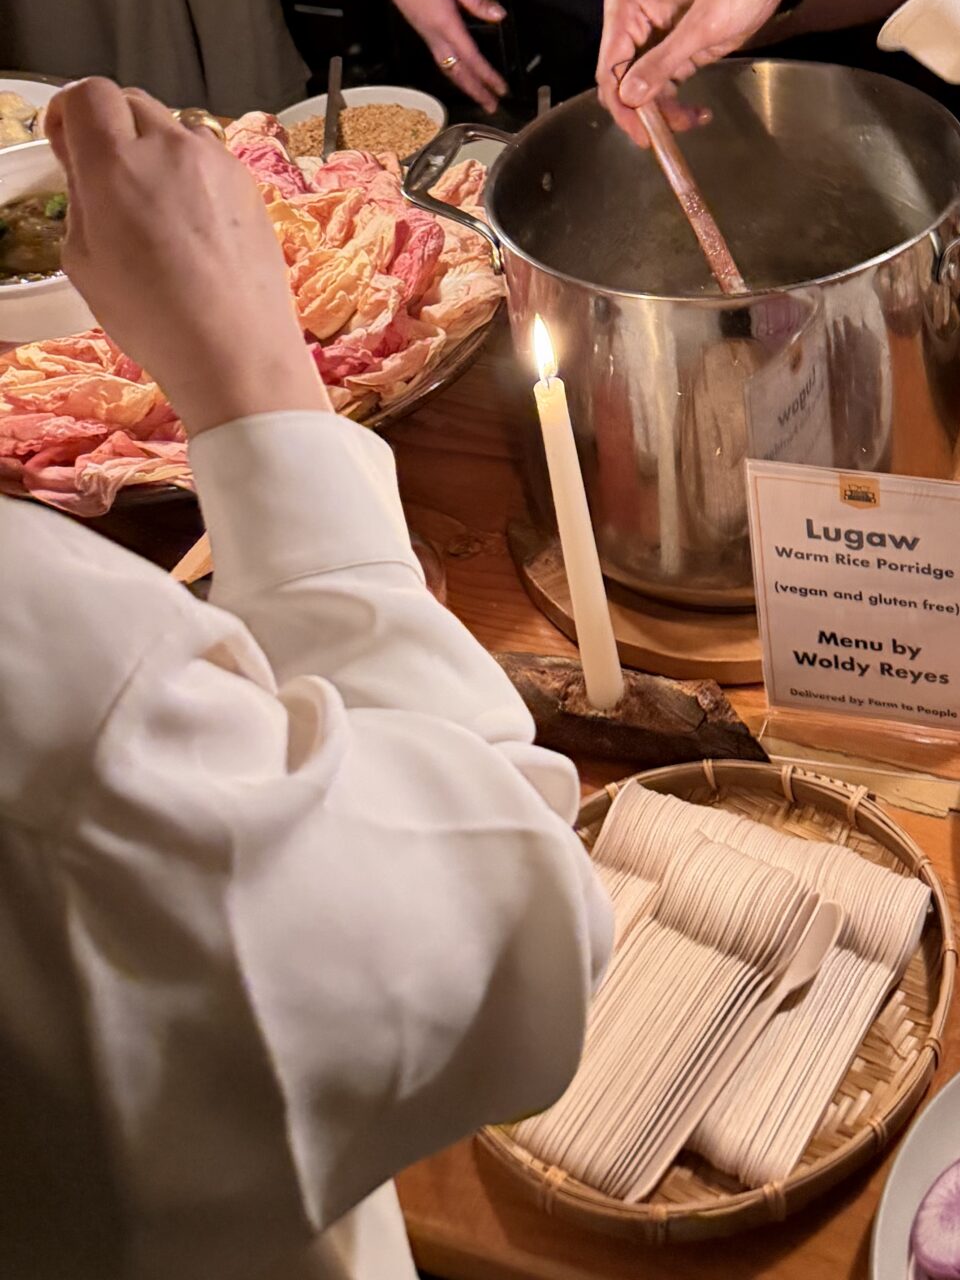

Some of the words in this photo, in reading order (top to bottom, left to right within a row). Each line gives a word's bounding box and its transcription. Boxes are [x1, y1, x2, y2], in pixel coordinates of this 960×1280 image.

[805, 518, 920, 551] Lugaw
[774, 546, 829, 564] Warm
[835, 552, 871, 569] Rice
[876, 558, 955, 580] Porridge
[774, 581, 828, 599] (vegan
[833, 589, 863, 602] and
[868, 592, 918, 610] gluten
[923, 600, 960, 616] free)
[817, 630, 883, 652] Menu
[891, 638, 922, 661] by
[793, 650, 872, 677] Woldy
[879, 661, 950, 685] Reyes
[790, 688, 846, 704] Delivered
[849, 696, 864, 707] by
[868, 698, 898, 710] Farm
[902, 702, 914, 712] to
[917, 704, 958, 719] People
